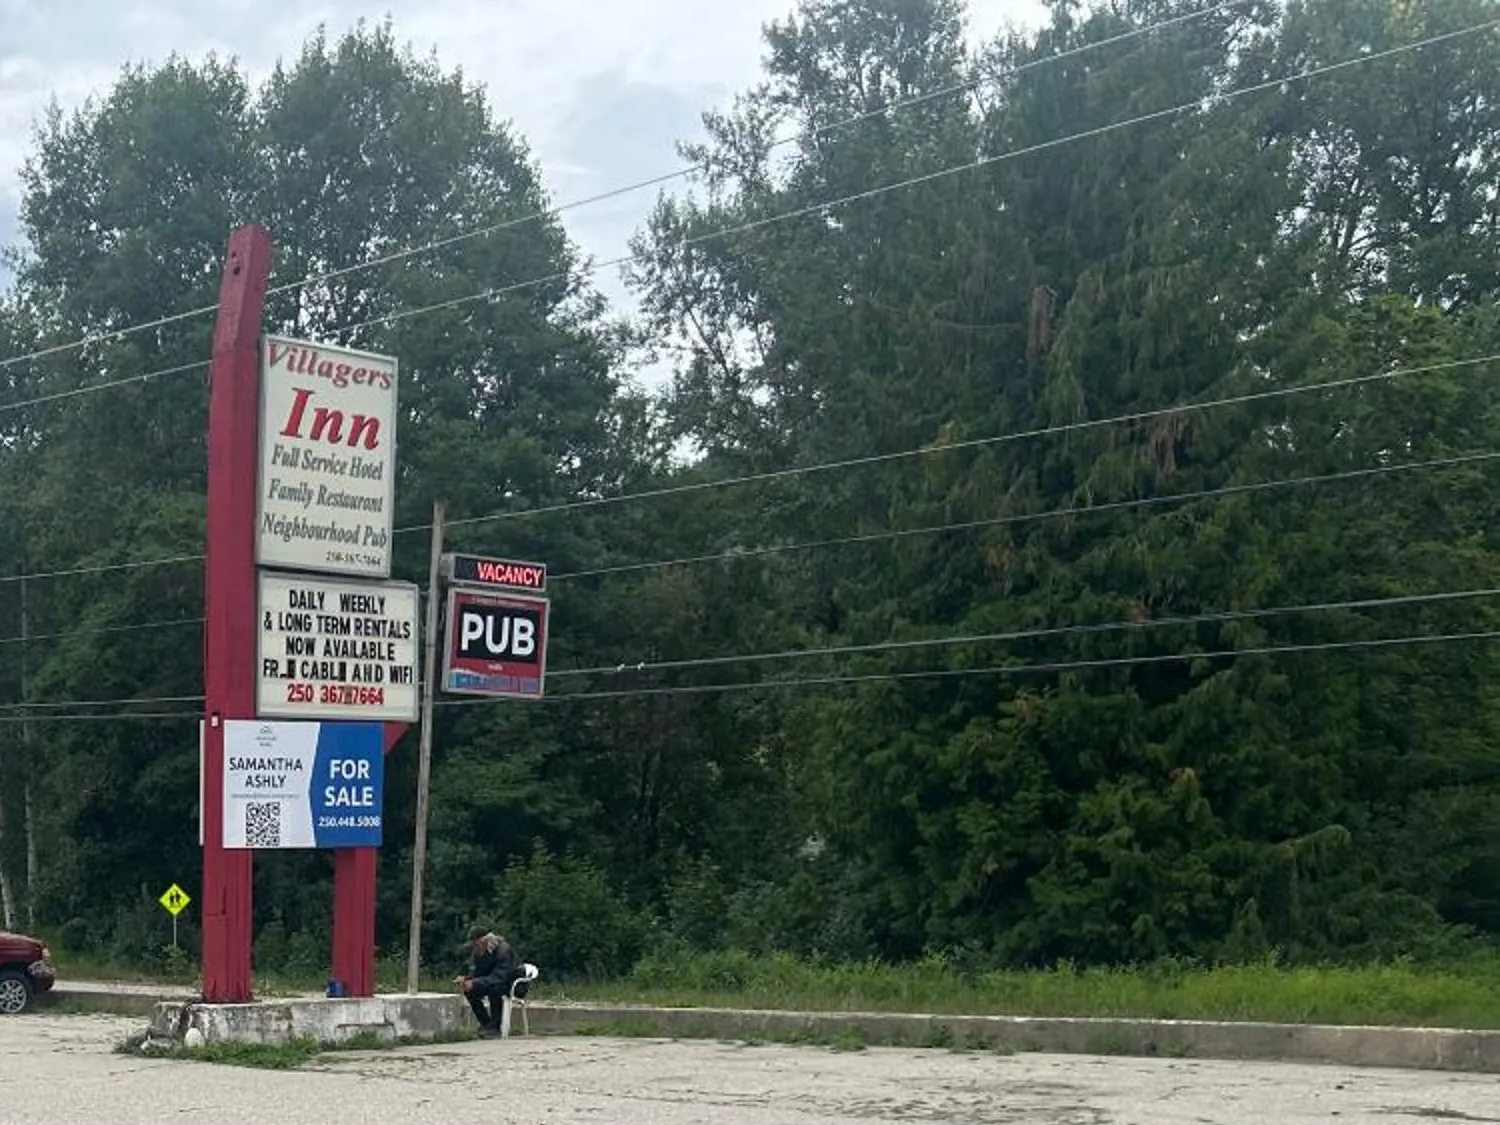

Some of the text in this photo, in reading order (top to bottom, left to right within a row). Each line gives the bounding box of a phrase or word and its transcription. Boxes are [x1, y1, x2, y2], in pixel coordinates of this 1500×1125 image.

[268, 343, 392, 391] Villagers
[280, 386, 381, 450] Inn
[272, 443, 383, 481] Full Service Hotel
[268, 477, 383, 513] Family Restaurant
[263, 511, 387, 548] Neighbourhood Pub
[477, 561, 543, 586] VACANCY
[289, 589, 386, 616] DAILY WEEKLY
[264, 611, 411, 639] & LONG TERM RENTALS
[461, 612, 535, 657] PUB
[286, 636, 395, 661] NOW AVAILABLE
[352, 664, 384, 684] AND
[389, 666, 414, 685] WIFI
[287, 684, 315, 704] 250
[229, 757, 303, 771] SAMANTHA
[329, 759, 370, 780] FOR
[245, 775, 286, 788] ASHLY
[324, 786, 374, 807] SALE
